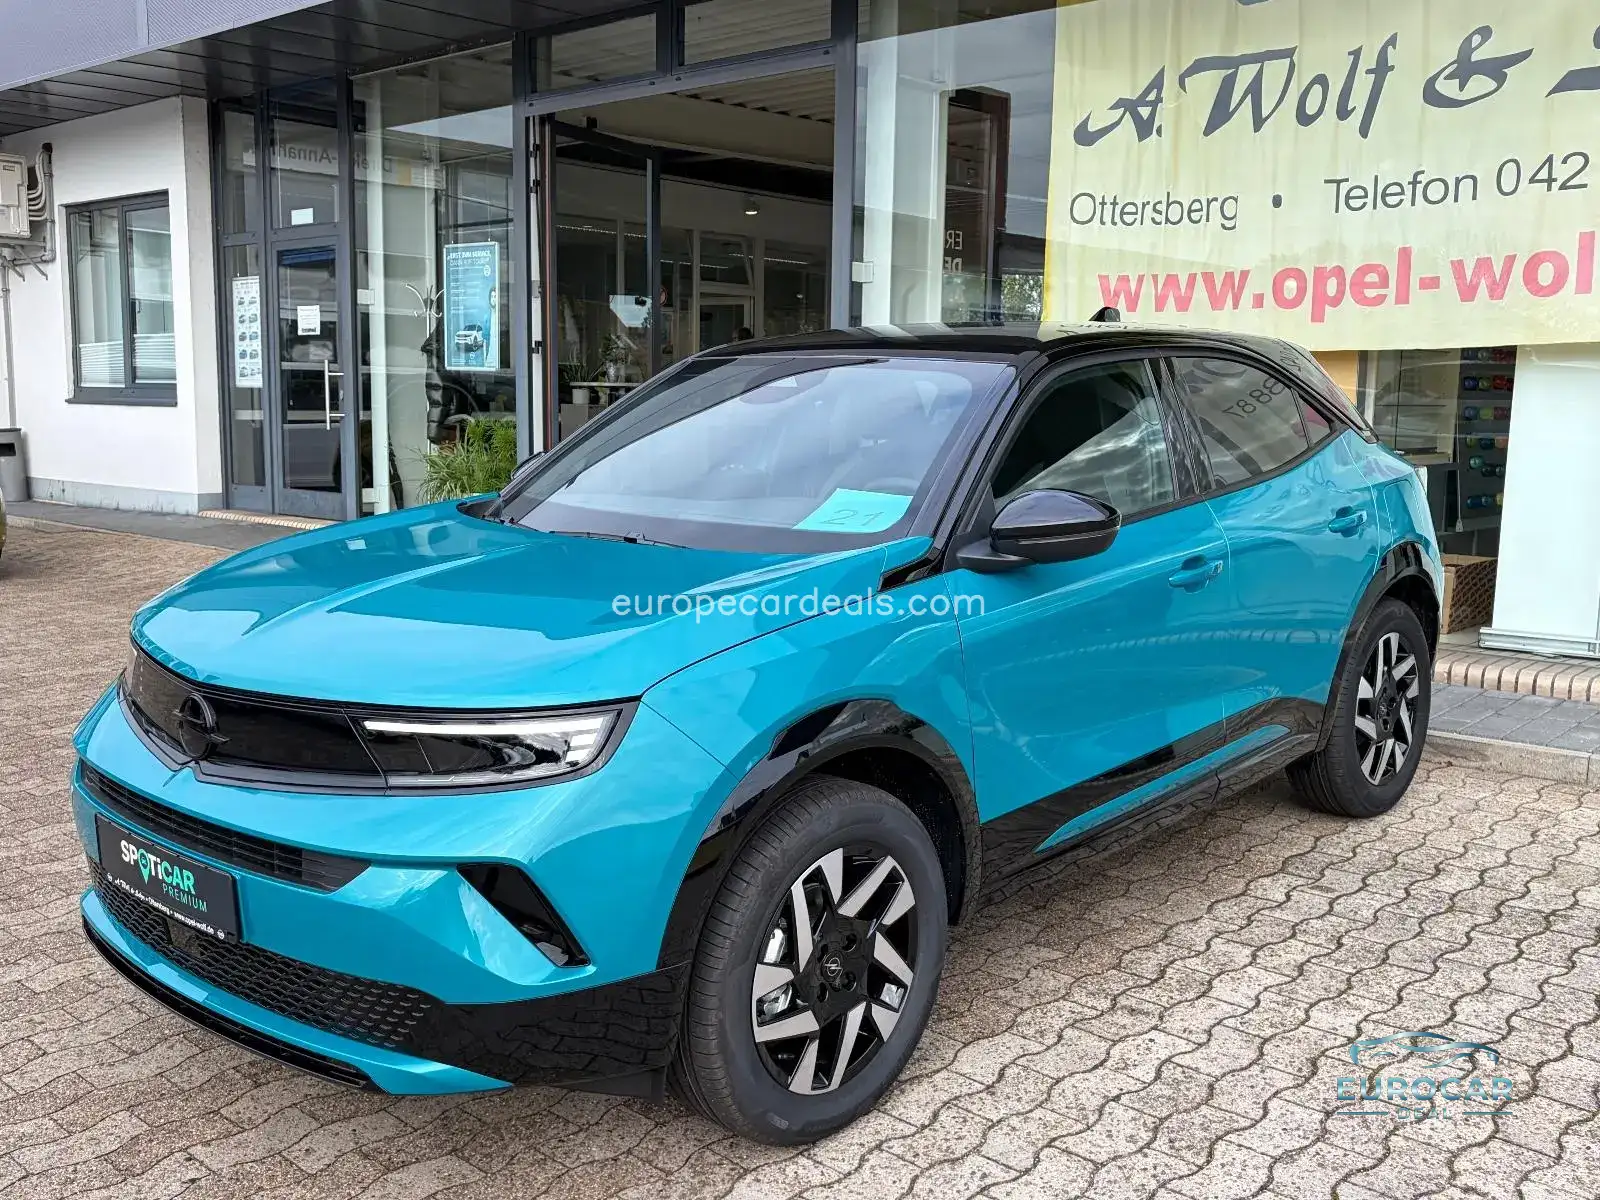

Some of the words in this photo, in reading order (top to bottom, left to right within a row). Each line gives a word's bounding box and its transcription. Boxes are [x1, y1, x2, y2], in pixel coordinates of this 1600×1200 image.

[1073, 65, 1166, 147] A.
[1178, 32, 1398, 139] Wolf
[1422, 25, 1534, 109] &
[1069, 191, 1239, 231] Ottersberg
[1323, 169, 1479, 214] Telefon
[819, 508, 885, 527] 21
[162, 883, 208, 913] PREMIUM
